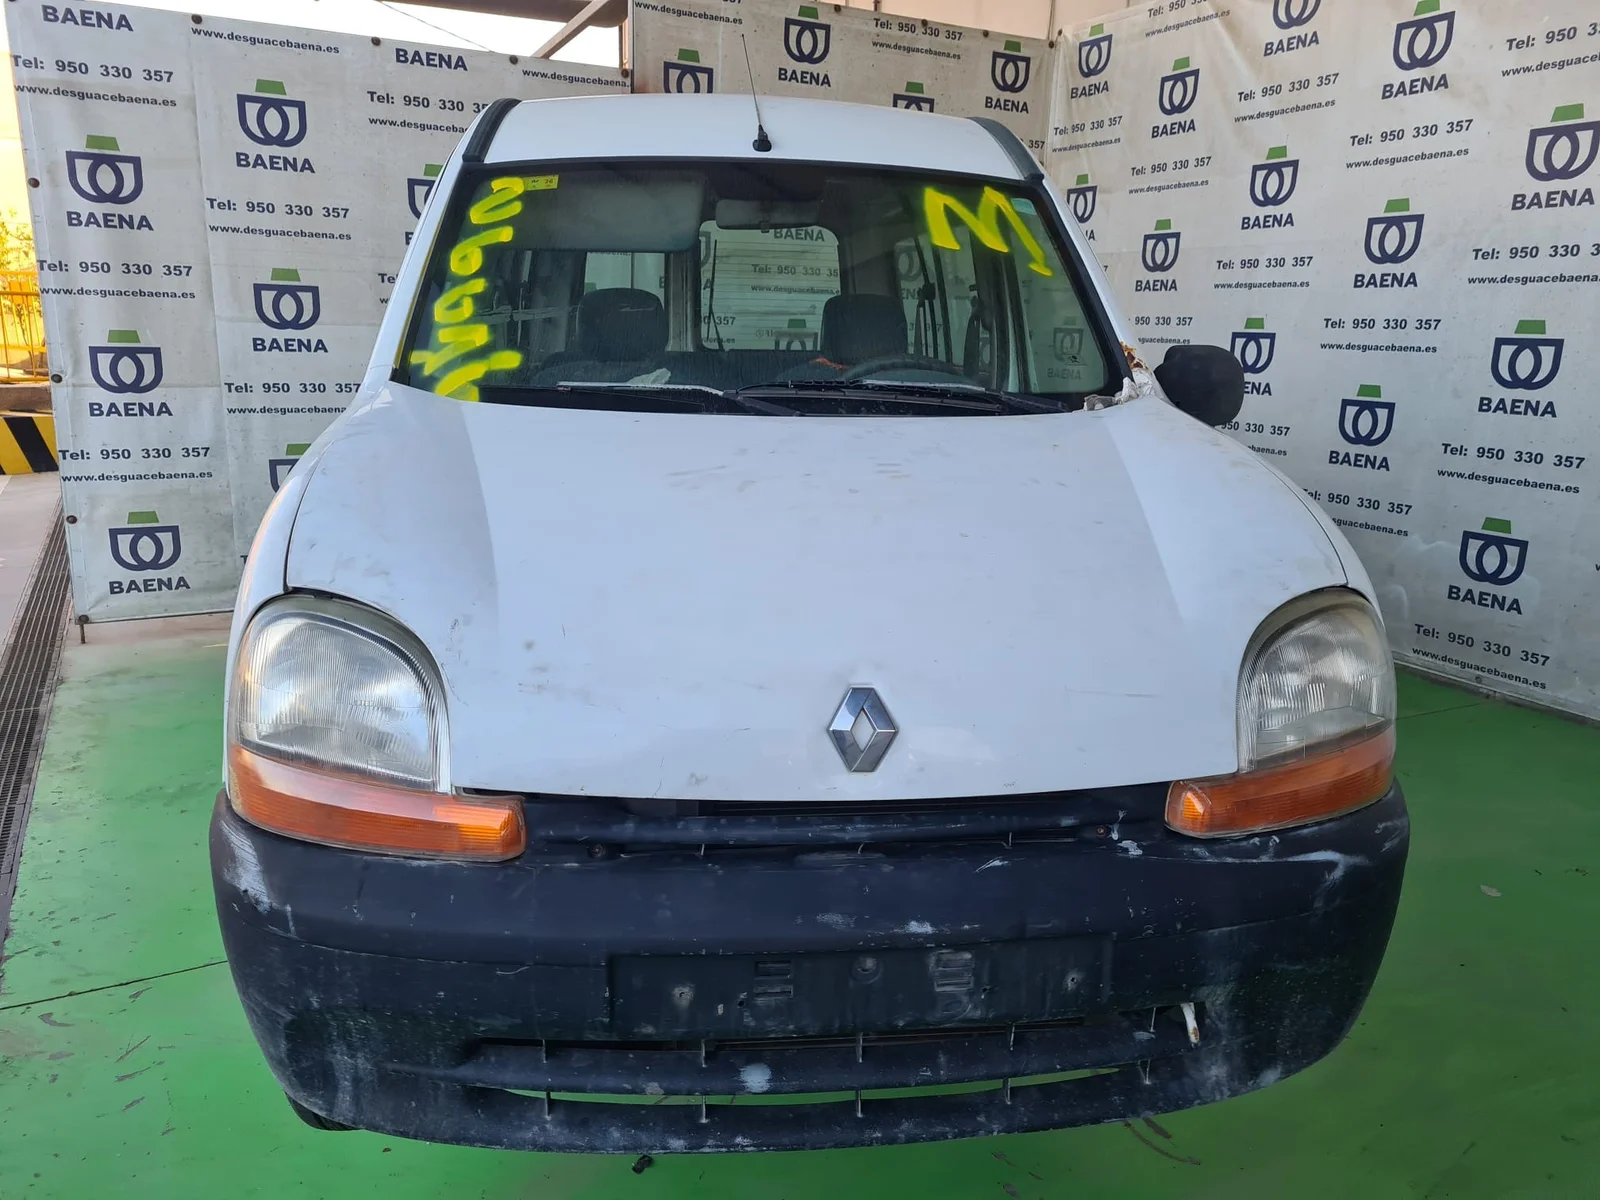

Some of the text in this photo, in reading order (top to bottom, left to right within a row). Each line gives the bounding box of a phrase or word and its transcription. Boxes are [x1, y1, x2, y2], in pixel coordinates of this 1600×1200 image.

[41, 5, 134, 31] BAENA
[634, 1, 743, 25] www.desguacebaena.es
[1147, 0, 1186, 18] Tel: 950
[874, 18, 963, 41] Tel: 950 330 357
[1145, 9, 1230, 38] www.desguacebaena.es
[191, 26, 340, 54] www.desguacebaena.es
[1264, 31, 1319, 57] BAENA
[1506, 35, 1536, 51] Tel:
[1545, 26, 1578, 44] 950
[395, 48, 468, 71] BAENA
[872, 40, 961, 60] www.desguacebaena.es
[12, 55, 174, 83] Tel: 950 330 357
[1501, 53, 1600, 77] www.desguace
[522, 68, 632, 88] www.desguacebaena.
[778, 67, 832, 87] BAENA
[1381, 73, 1449, 100] BAENA
[13, 84, 177, 107] www.desguacebaena.es
[1070, 81, 1109, 99] BAENA
[1238, 73, 1339, 102] Tel: 950 330 357
[367, 91, 395, 104] Tel:
[403, 95, 430, 108] 950
[439, 99, 465, 112] 330
[985, 96, 1029, 114] BAENA
[1234, 98, 1336, 123] www.desguacebaena.es
[368, 117, 468, 133] www.desguaceba
[1054, 115, 1123, 136] Tel: 950 330 357
[1151, 119, 1196, 138] BAENA
[1350, 119, 1473, 146] Tel: 950 330 357
[1028, 139, 1045, 150] 357
[236, 152, 316, 173] BAENA
[1131, 156, 1212, 177] Tel: 950 330 357
[1346, 148, 1469, 169] www.desguacebaena.es
[1128, 179, 1209, 195] www.desguacebaena.es
[206, 198, 350, 219] Tel: 950 330 357
[1511, 188, 1595, 211] BAENA
[66, 211, 154, 231] BAENA
[1241, 213, 1294, 230] BAENA
[209, 223, 352, 240] www.desguacebaena.es
[773, 228, 825, 242] BAENA
[1472, 248, 1500, 260] Tel:
[1509, 246, 1539, 259] 950
[1548, 244, 1580, 258] 330
[37, 260, 193, 277] Tel: 950 330 357
[751, 264, 838, 278] Tel: 950 330 35
[1217, 256, 1313, 270] Tel: 950 330 357
[1135, 279, 1178, 292] BAENA
[1214, 280, 1310, 291] www.desguacebaena.es
[1353, 272, 1418, 289] BAENA
[1468, 273, 1600, 285] www.desguacebaena.
[39, 286, 195, 300] www.desguacebaena.es
[1134, 316, 1193, 326] 950 330 357
[1323, 318, 1442, 330] Tel: 950 330 357
[252, 337, 329, 353] BAENA
[1320, 342, 1437, 353] www.desguacebaena.es
[224, 382, 361, 393] Tel: 950 330 357
[1244, 381, 1272, 396] ENA
[88, 402, 173, 417] BAENA
[227, 406, 347, 415] www.desguacebaena
[1478, 396, 1558, 418] BAENA
[1245, 422, 1264, 434] 330
[1270, 425, 1291, 437] 357
[59, 447, 211, 461] Tel: 950 330 357
[1329, 450, 1390, 471] BAENA
[1441, 443, 1585, 469] Tel: 950 330 357
[61, 470, 213, 483] www.desguacebaena.es
[1437, 468, 1580, 494] www.desguacebaena.es
[1327, 492, 1350, 505] 950
[1356, 497, 1381, 510] 330
[1387, 502, 1412, 515] 357
[109, 576, 191, 595] BAENA
[1447, 584, 1523, 615] BAENA
[1415, 624, 1550, 667] Tel: 950 330 357
[1412, 647, 1547, 690] www.desguacebaena.es
